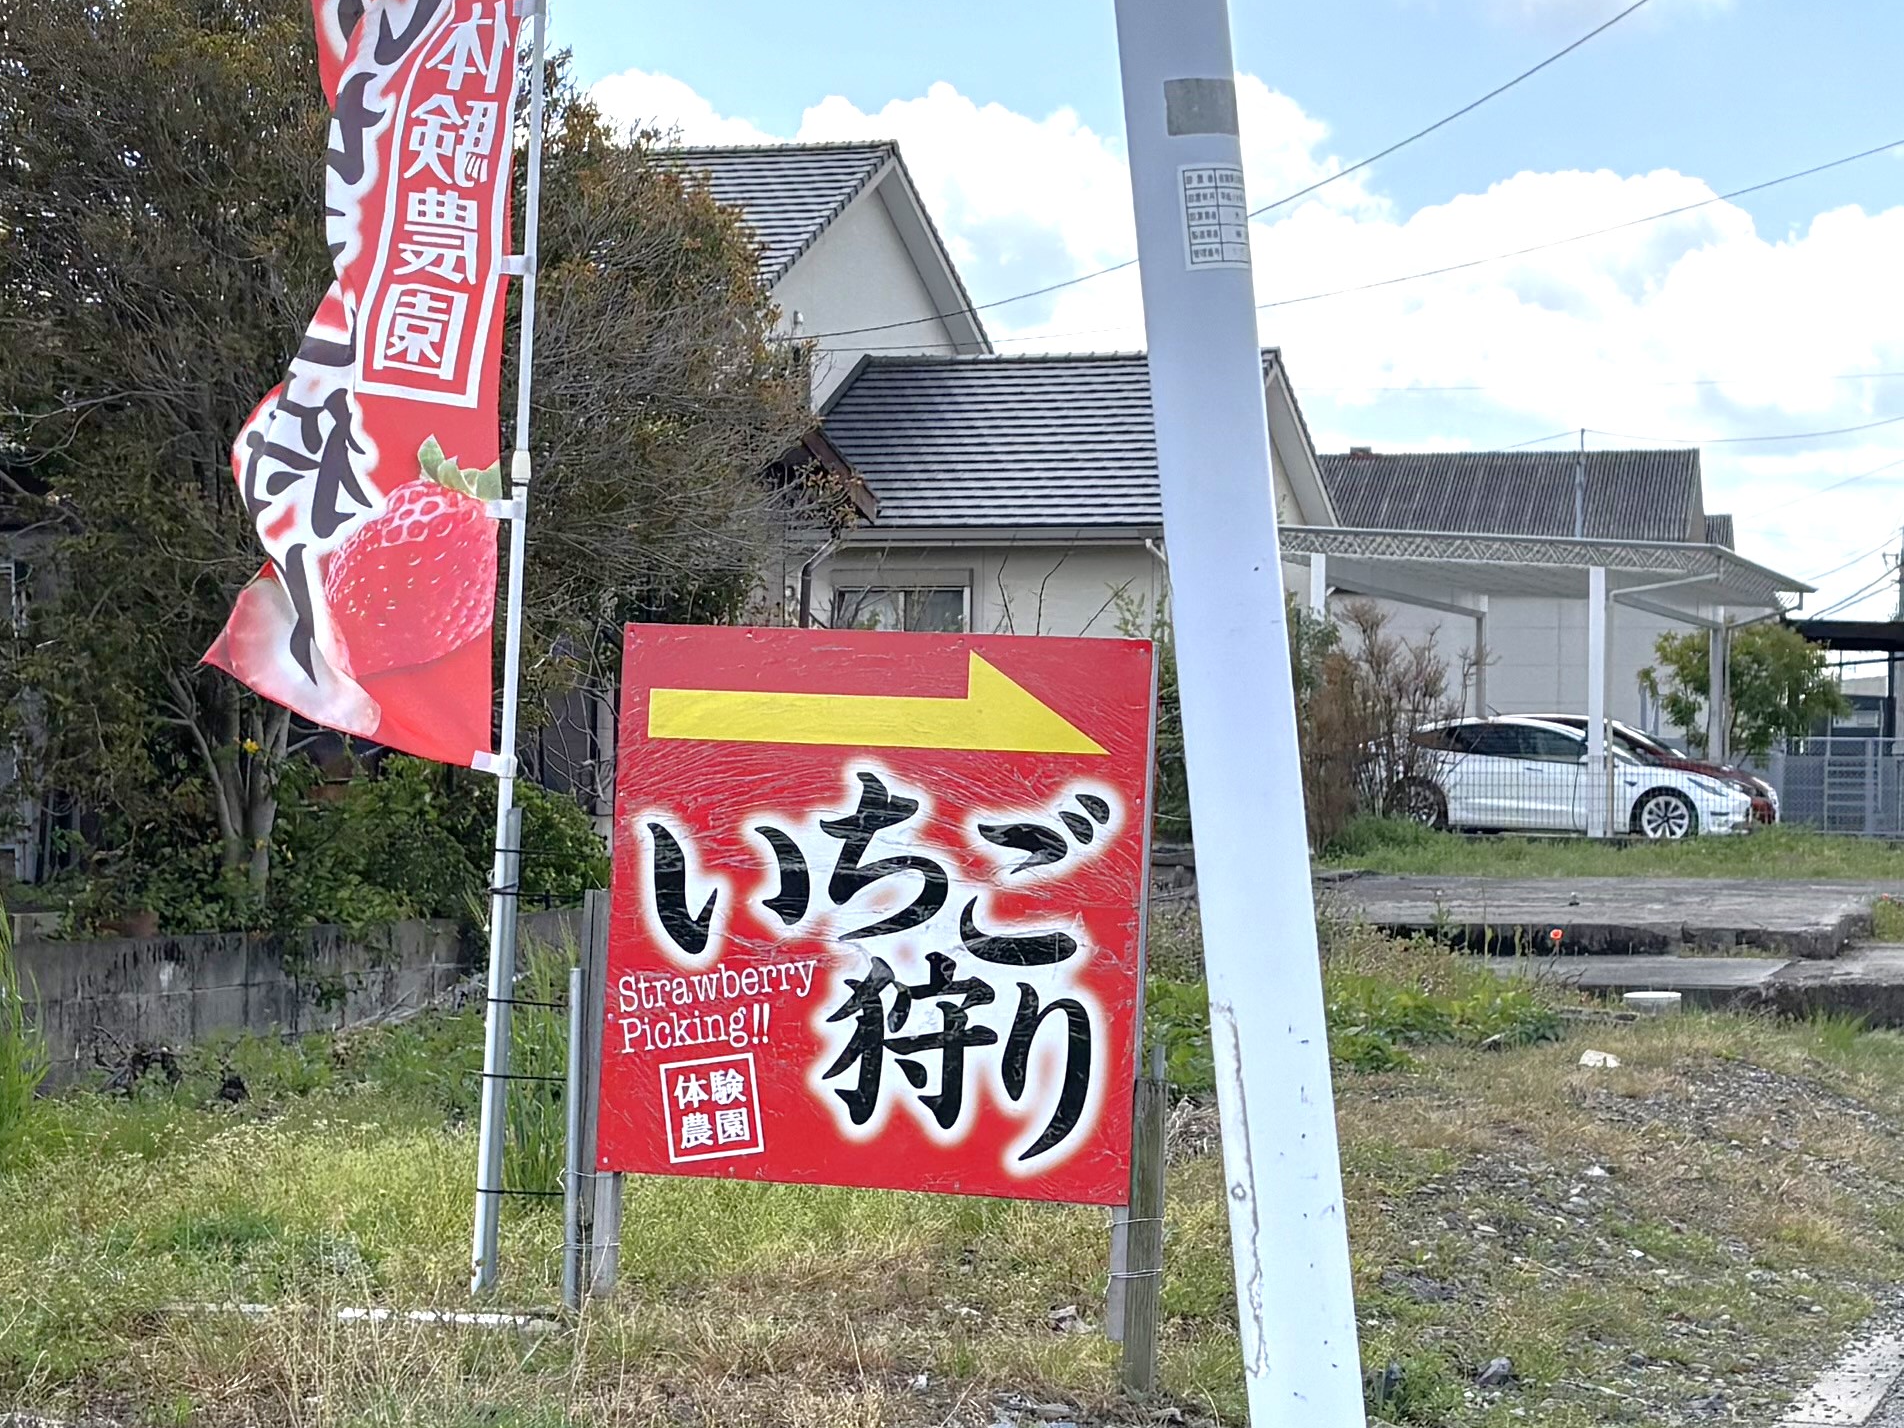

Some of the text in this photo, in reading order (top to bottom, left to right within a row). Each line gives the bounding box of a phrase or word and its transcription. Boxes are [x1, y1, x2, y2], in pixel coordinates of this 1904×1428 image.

[647, 772, 1110, 967] いちご
[618, 960, 817, 1013] Strawberry
[618, 1002, 770, 1054] Picking!!
[822, 953, 1092, 1162] 狩り
[673, 1068, 747, 1110] 体験
[680, 1107, 751, 1149] 農園
